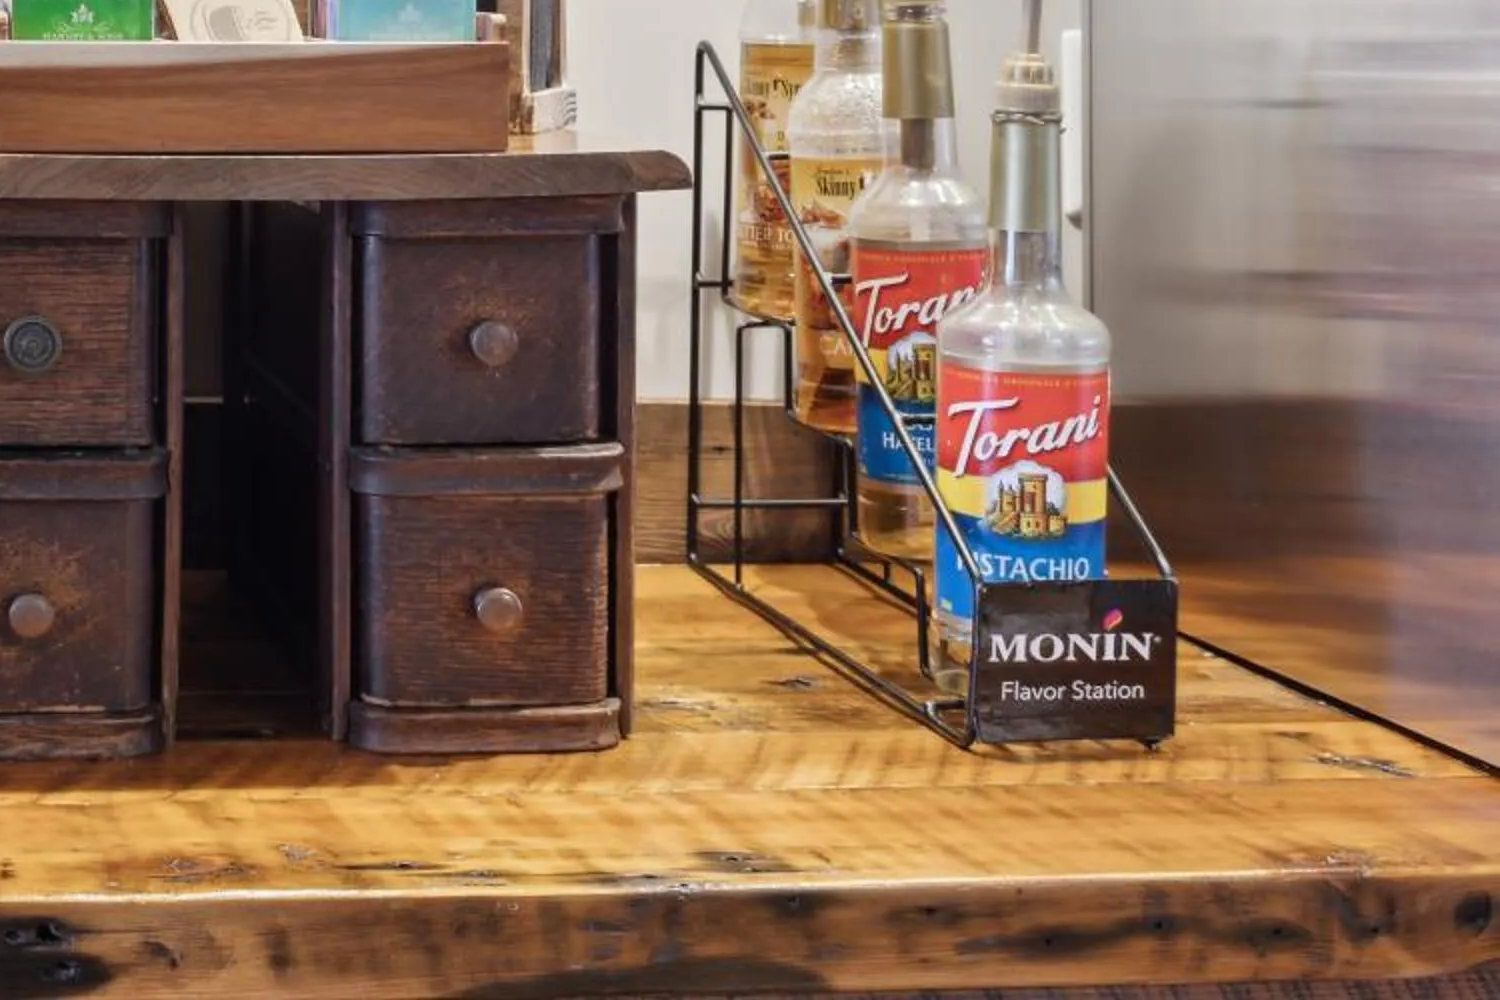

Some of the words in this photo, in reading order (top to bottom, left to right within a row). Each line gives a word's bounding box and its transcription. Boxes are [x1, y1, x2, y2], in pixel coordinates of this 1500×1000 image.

[816, 175, 857, 201] Skinny
[948, 395, 1102, 478] Torani
[987, 632, 1153, 663] MONIN
[1001, 680, 1065, 701] Flavor
[1071, 679, 1145, 700] Station
